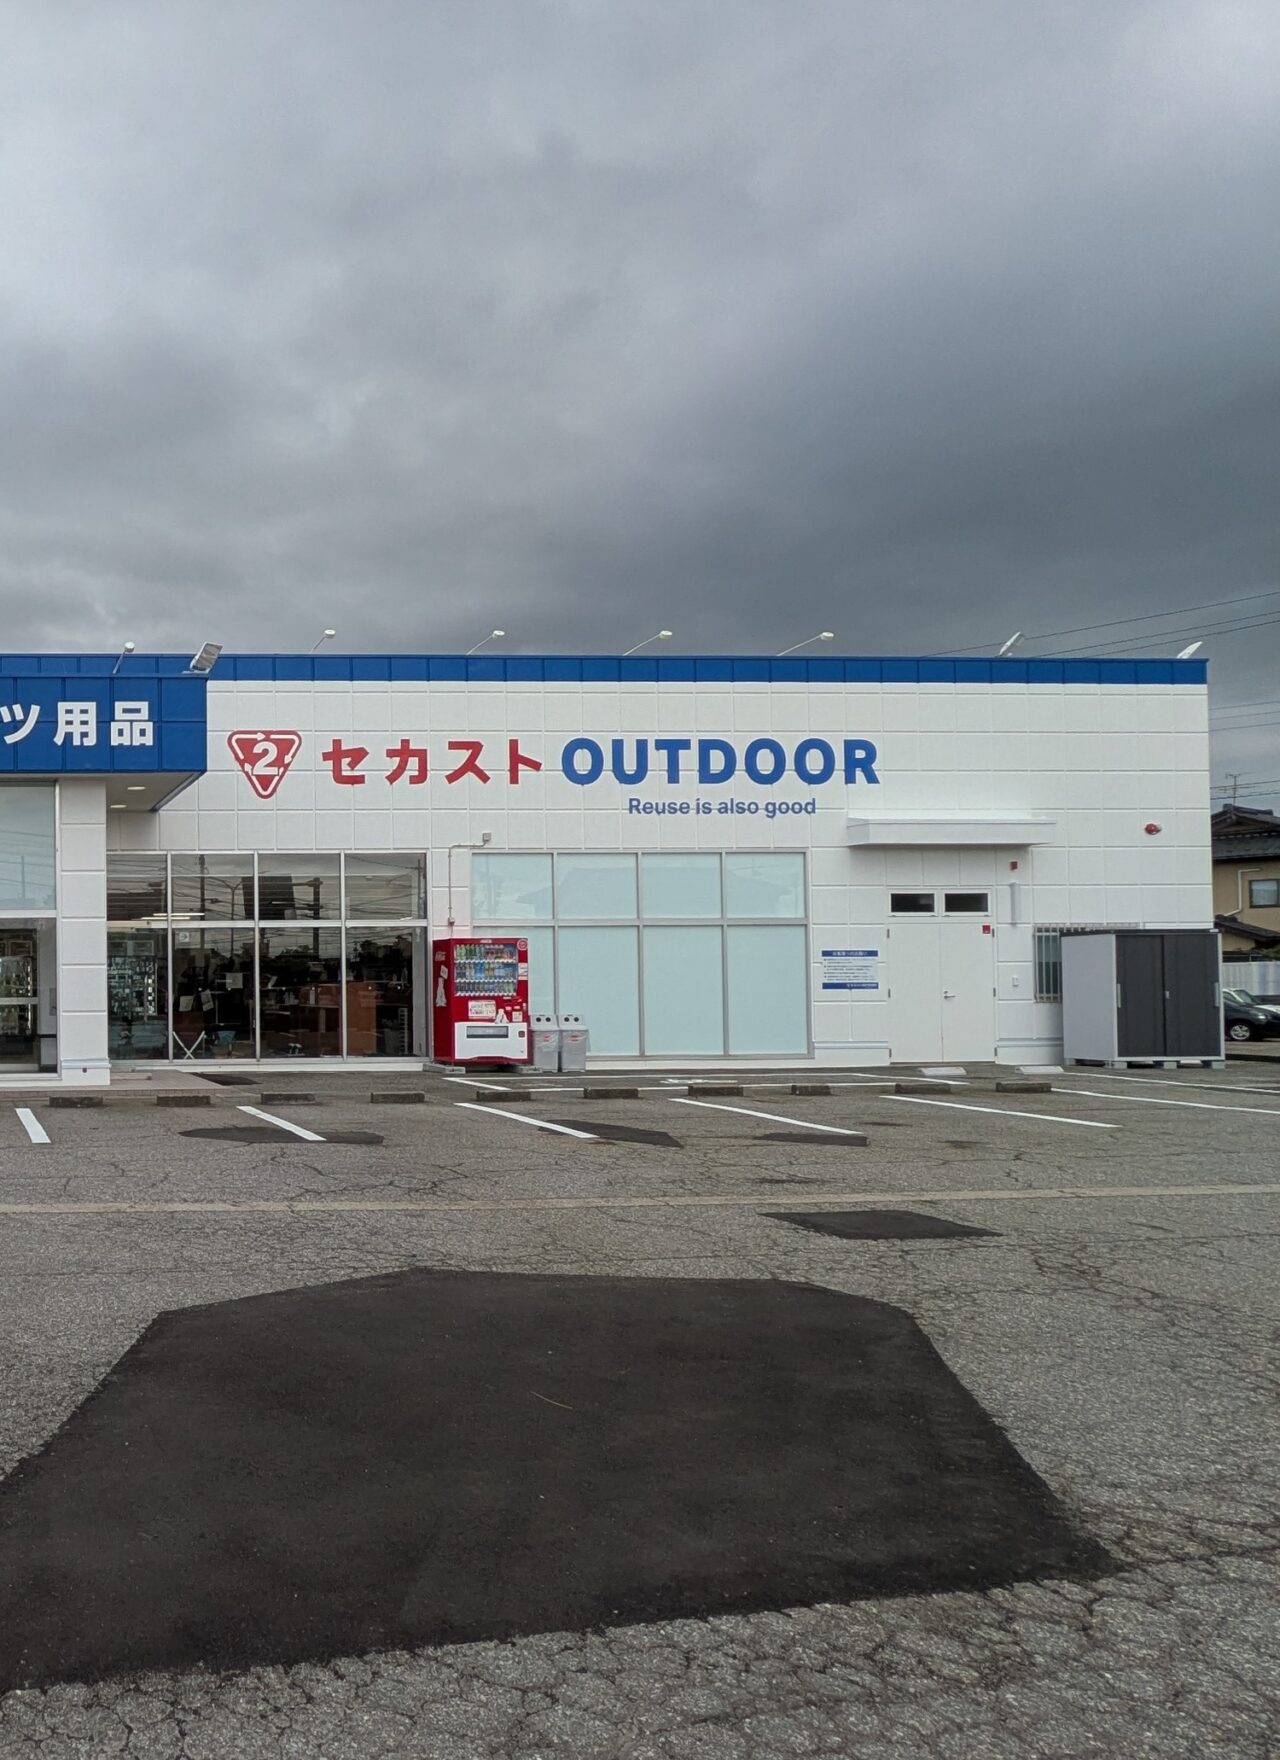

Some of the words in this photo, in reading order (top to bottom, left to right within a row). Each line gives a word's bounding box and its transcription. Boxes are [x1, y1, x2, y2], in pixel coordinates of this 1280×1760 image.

[322, 738, 542, 785] セカスト
[561, 737, 880, 785] OUTDOOR
[628, 797, 690, 815] Reuse
[696, 797, 713, 815] is
[718, 797, 759, 815] also
[764, 797, 817, 819] good
